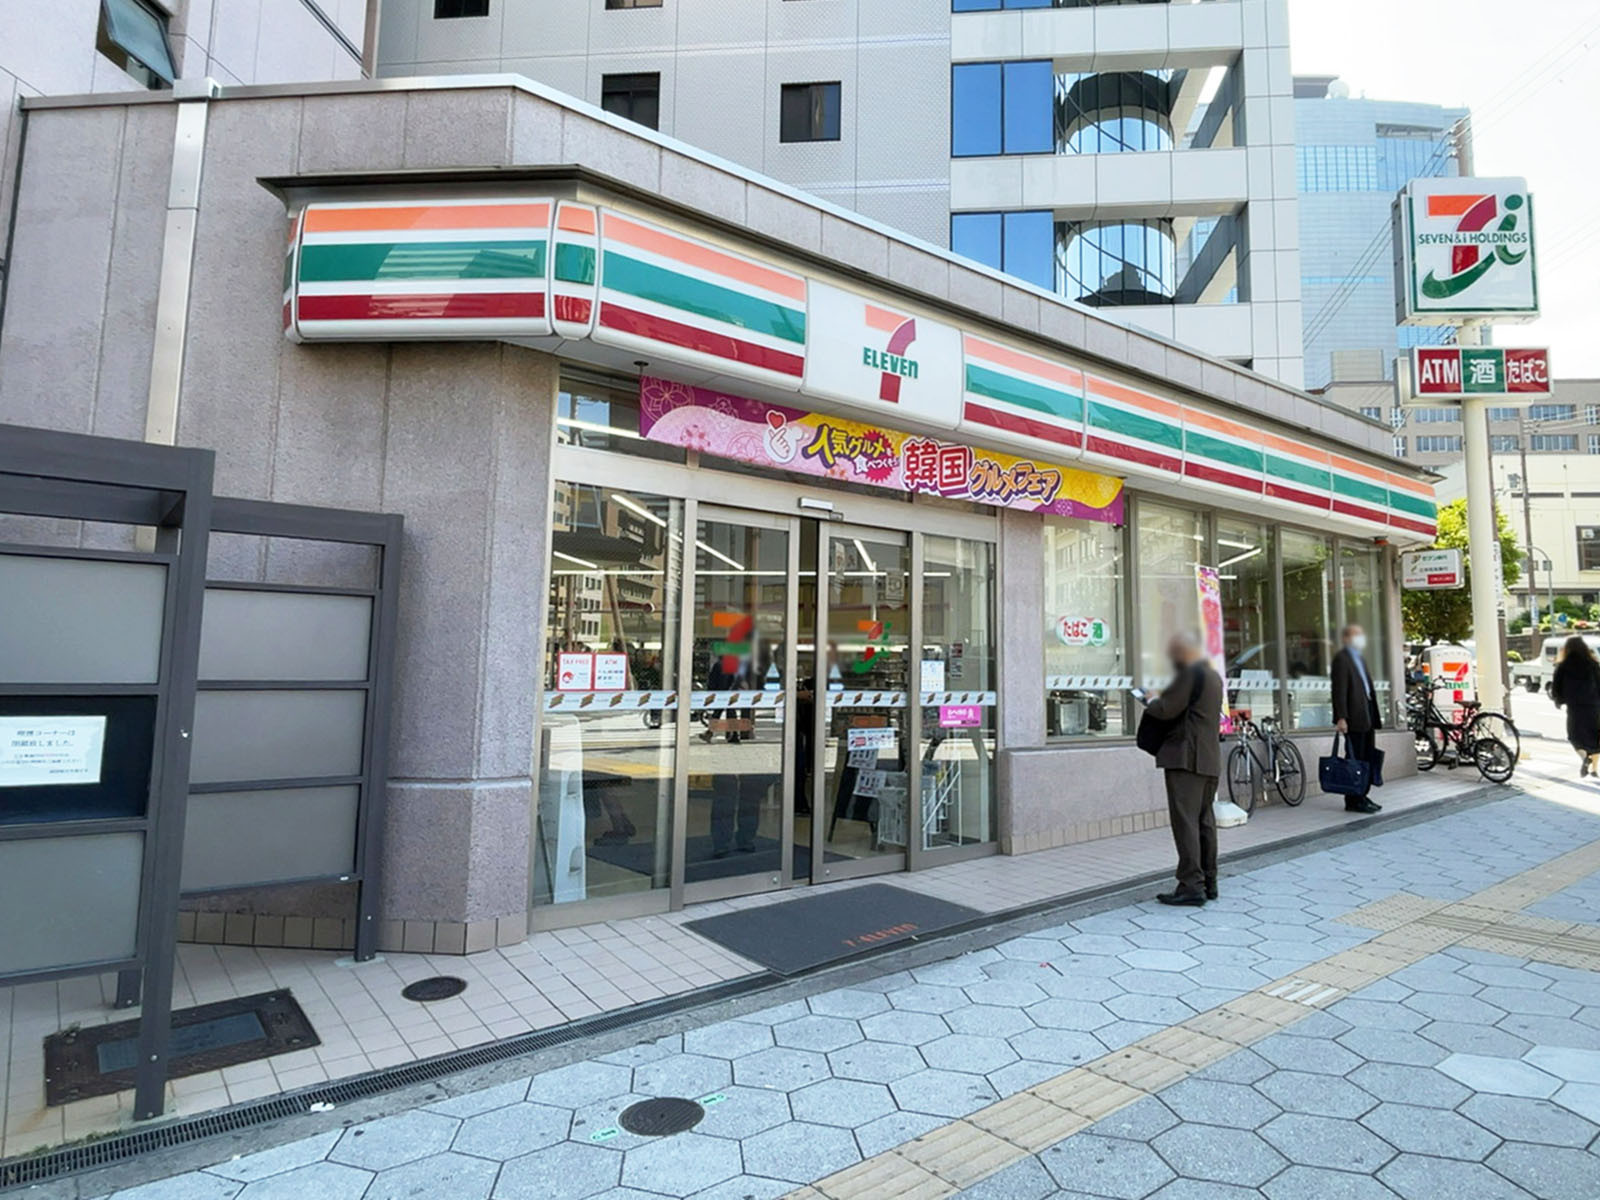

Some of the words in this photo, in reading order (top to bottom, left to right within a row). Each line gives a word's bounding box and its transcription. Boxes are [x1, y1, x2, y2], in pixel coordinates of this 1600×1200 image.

[1470, 232, 1528, 244] HOLDINGS
[1421, 358, 1459, 384] ATM
[1469, 358, 1496, 384] 酒
[1507, 357, 1548, 384] たばこ
[1063, 620, 1089, 637] たばこ
